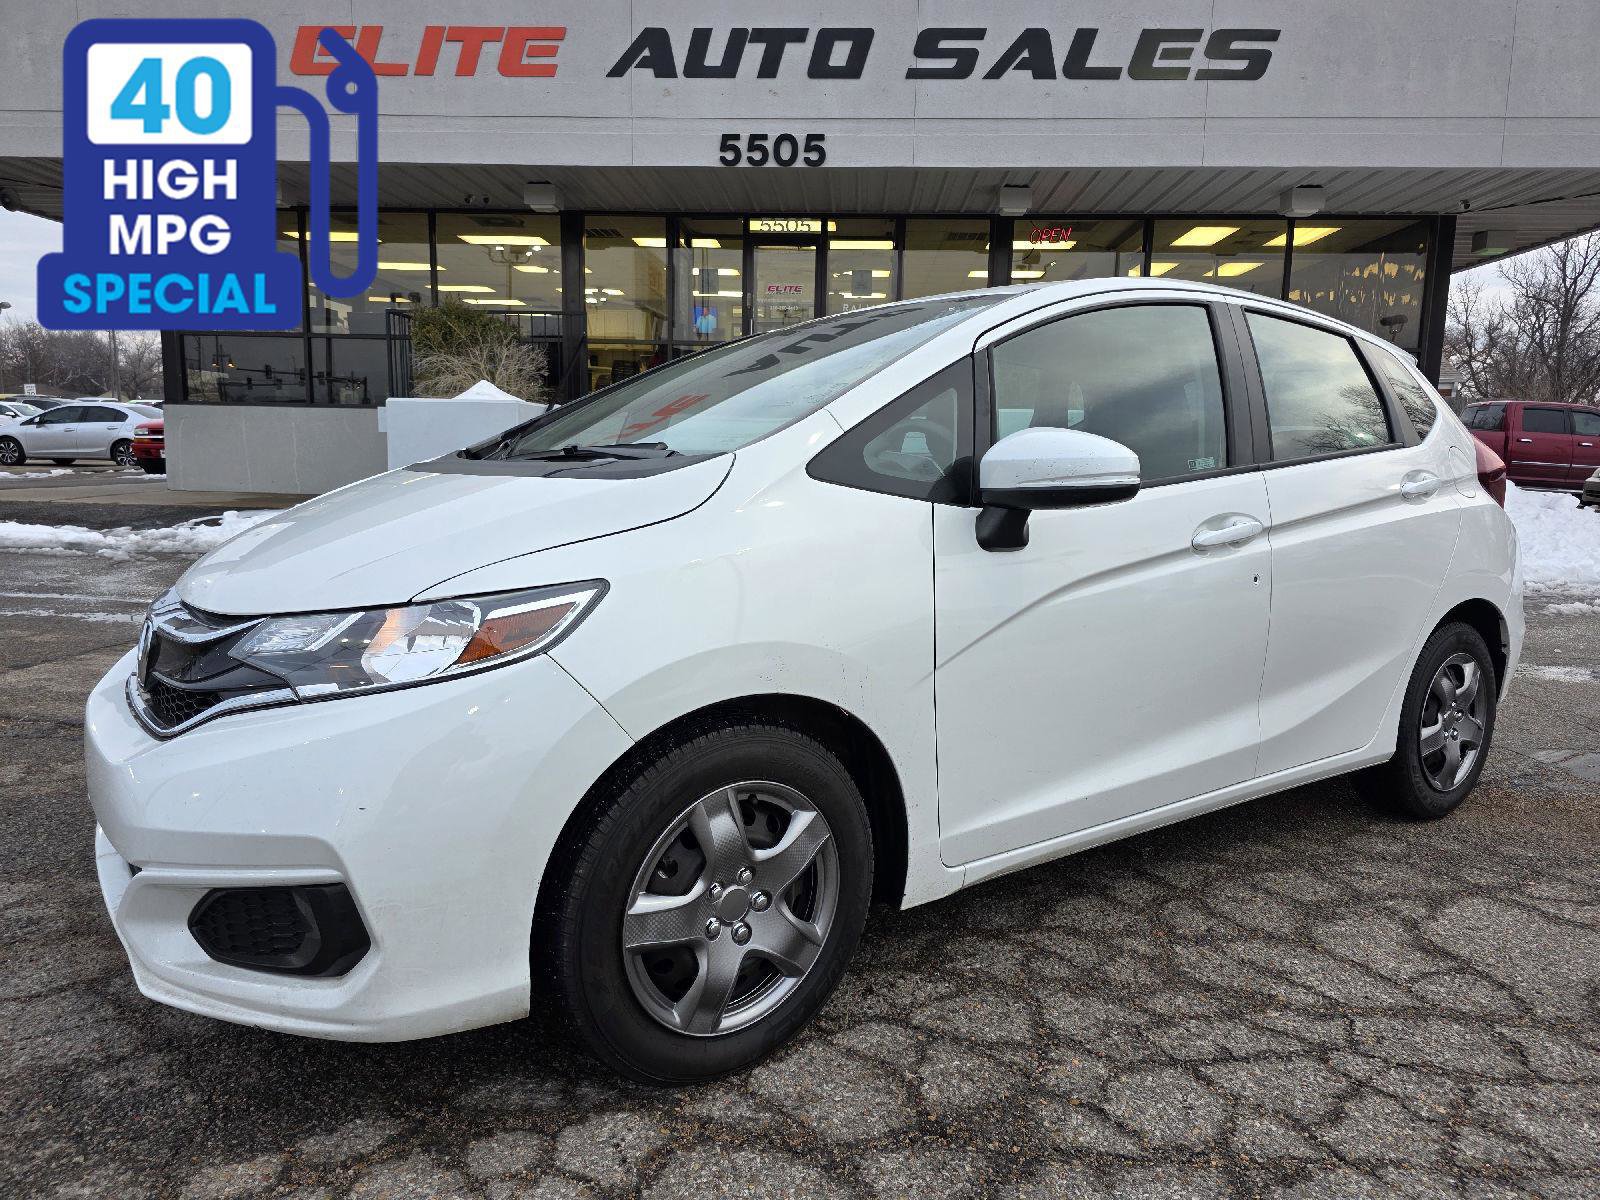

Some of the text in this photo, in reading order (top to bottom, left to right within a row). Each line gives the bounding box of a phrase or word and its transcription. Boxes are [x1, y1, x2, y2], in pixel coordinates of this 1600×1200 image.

[289, 25, 1282, 80] ELITE AUTO SALES
[719, 133, 827, 168] 5505
[761, 217, 811, 232] 5505
[1029, 226, 1073, 245] OPEN
